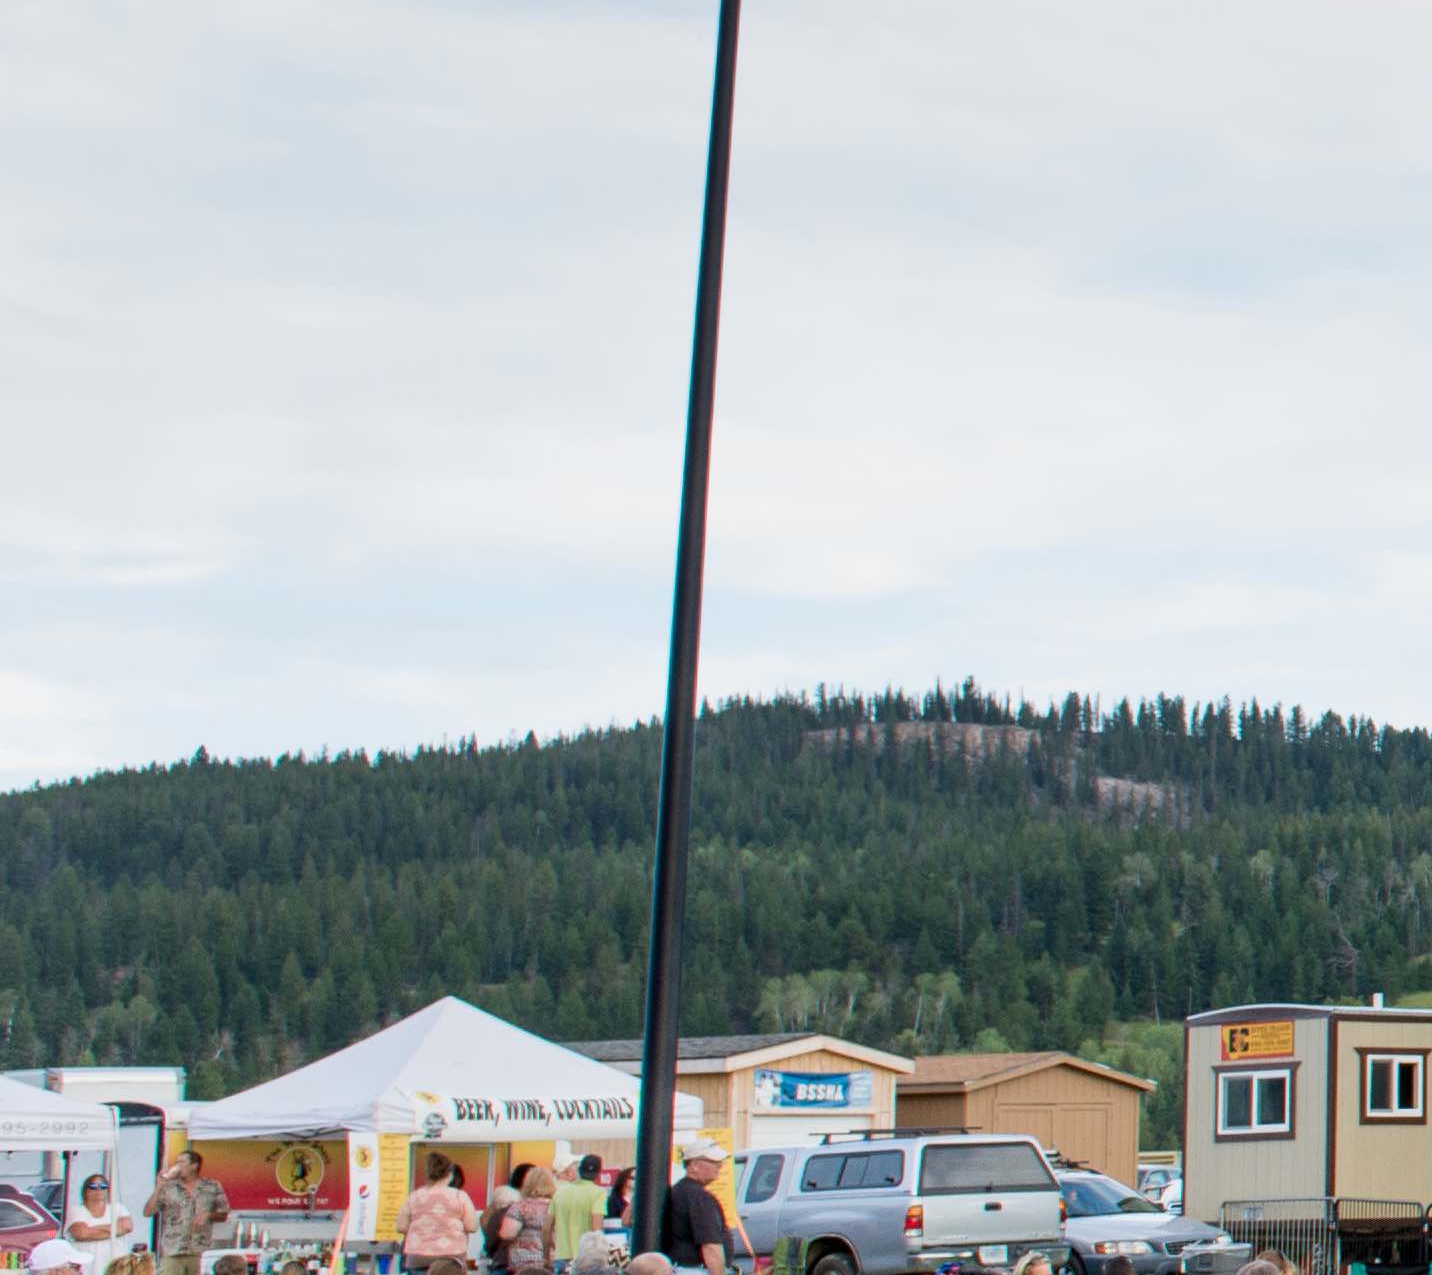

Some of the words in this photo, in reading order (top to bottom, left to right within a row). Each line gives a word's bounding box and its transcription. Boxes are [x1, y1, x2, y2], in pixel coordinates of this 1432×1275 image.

[452, 1098, 500, 1126] BEER,
[502, 1098, 551, 1126] WINE,
[552, 1097, 635, 1120] COCKTAILS
